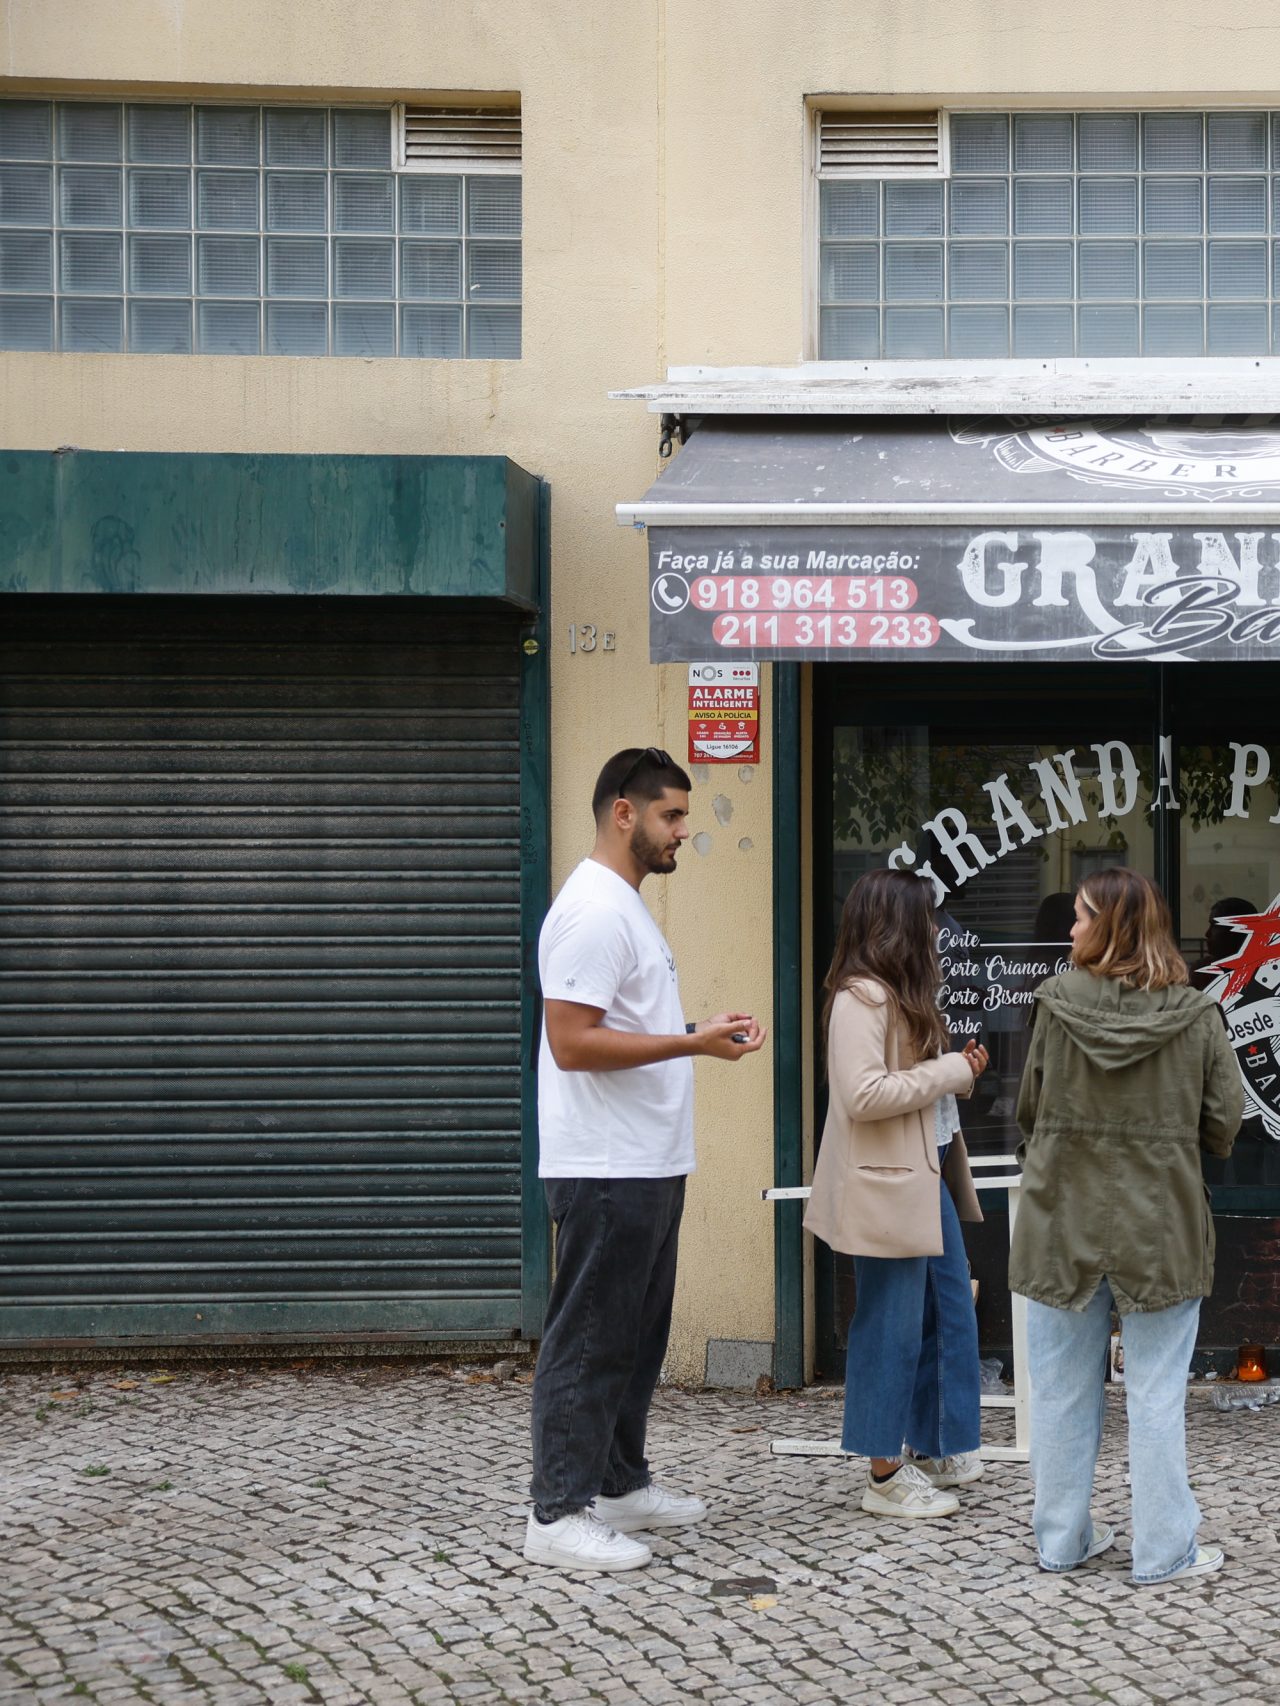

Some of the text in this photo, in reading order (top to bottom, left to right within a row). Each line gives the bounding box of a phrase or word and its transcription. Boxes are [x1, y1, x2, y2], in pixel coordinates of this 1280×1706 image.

[1045, 428, 1238, 478] BARBER
[657, 551, 921, 572] Faça já a sua Marcação:
[698, 579, 910, 609] 918 964 513
[721, 615, 933, 646] 211 313 233
[692, 666, 723, 681] NOS
[693, 688, 753, 699] ALARME
[717, 711, 723, 719] À
[724, 711, 752, 719] POLÍCIA
[936, 928, 981, 953] Corte
[940, 956, 981, 981] Corte
[985, 955, 1050, 981] Criança
[935, 984, 1034, 1012] Corte Bisem
